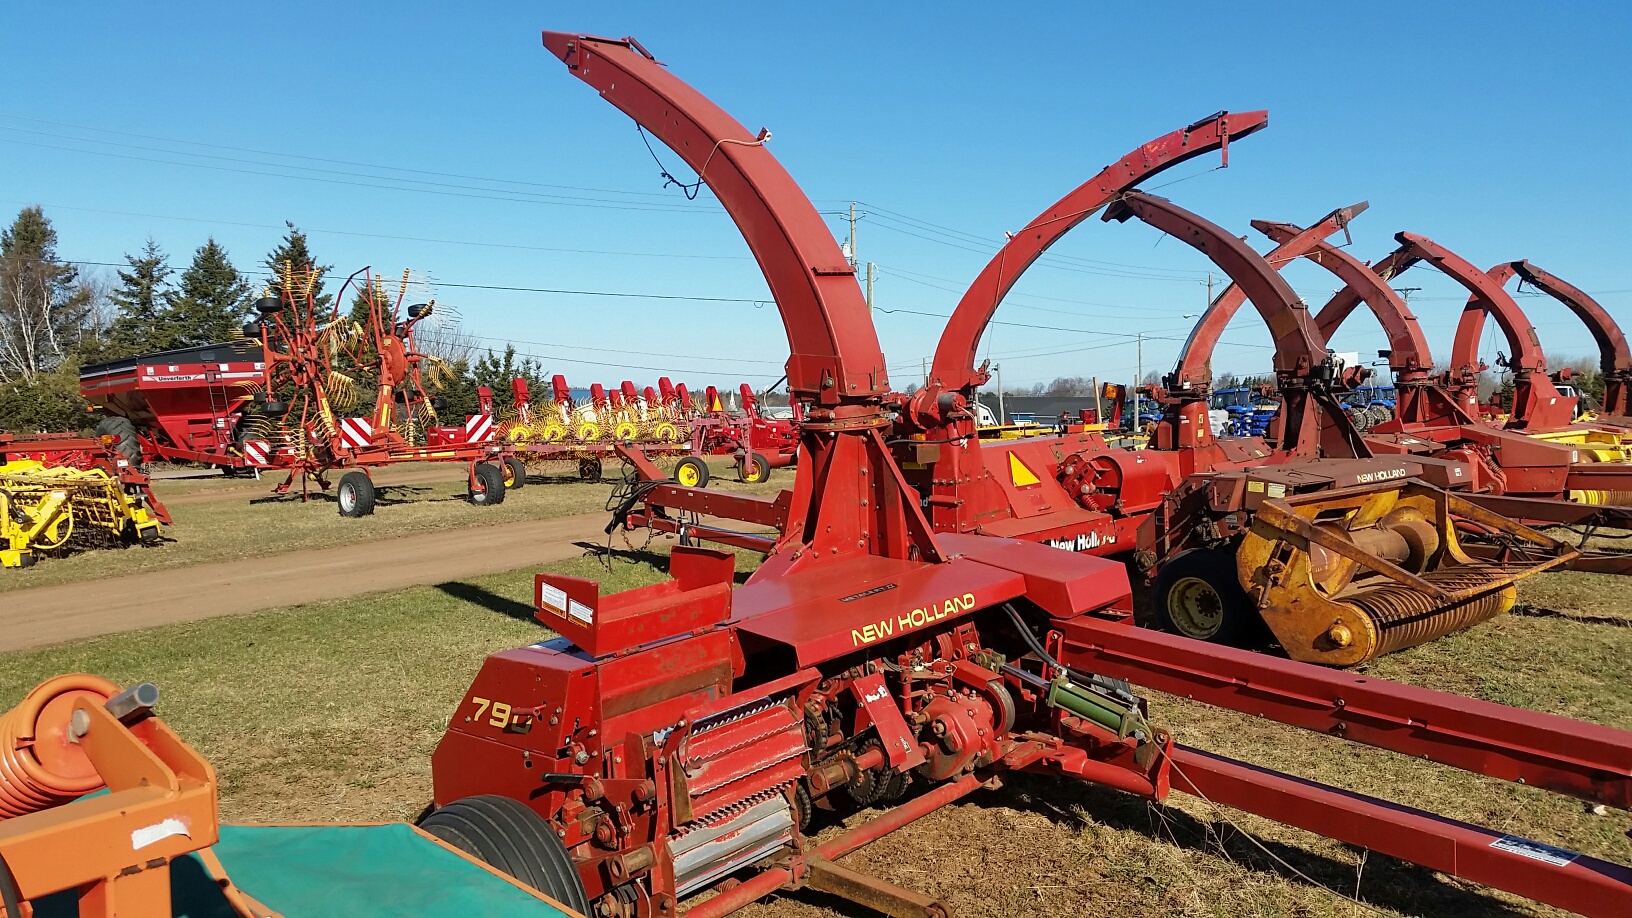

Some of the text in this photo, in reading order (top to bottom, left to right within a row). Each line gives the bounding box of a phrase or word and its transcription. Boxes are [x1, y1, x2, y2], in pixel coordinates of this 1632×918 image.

[1356, 468, 1406, 484] NEW HOLLAND
[851, 592, 976, 647] NEW HOLLAND
